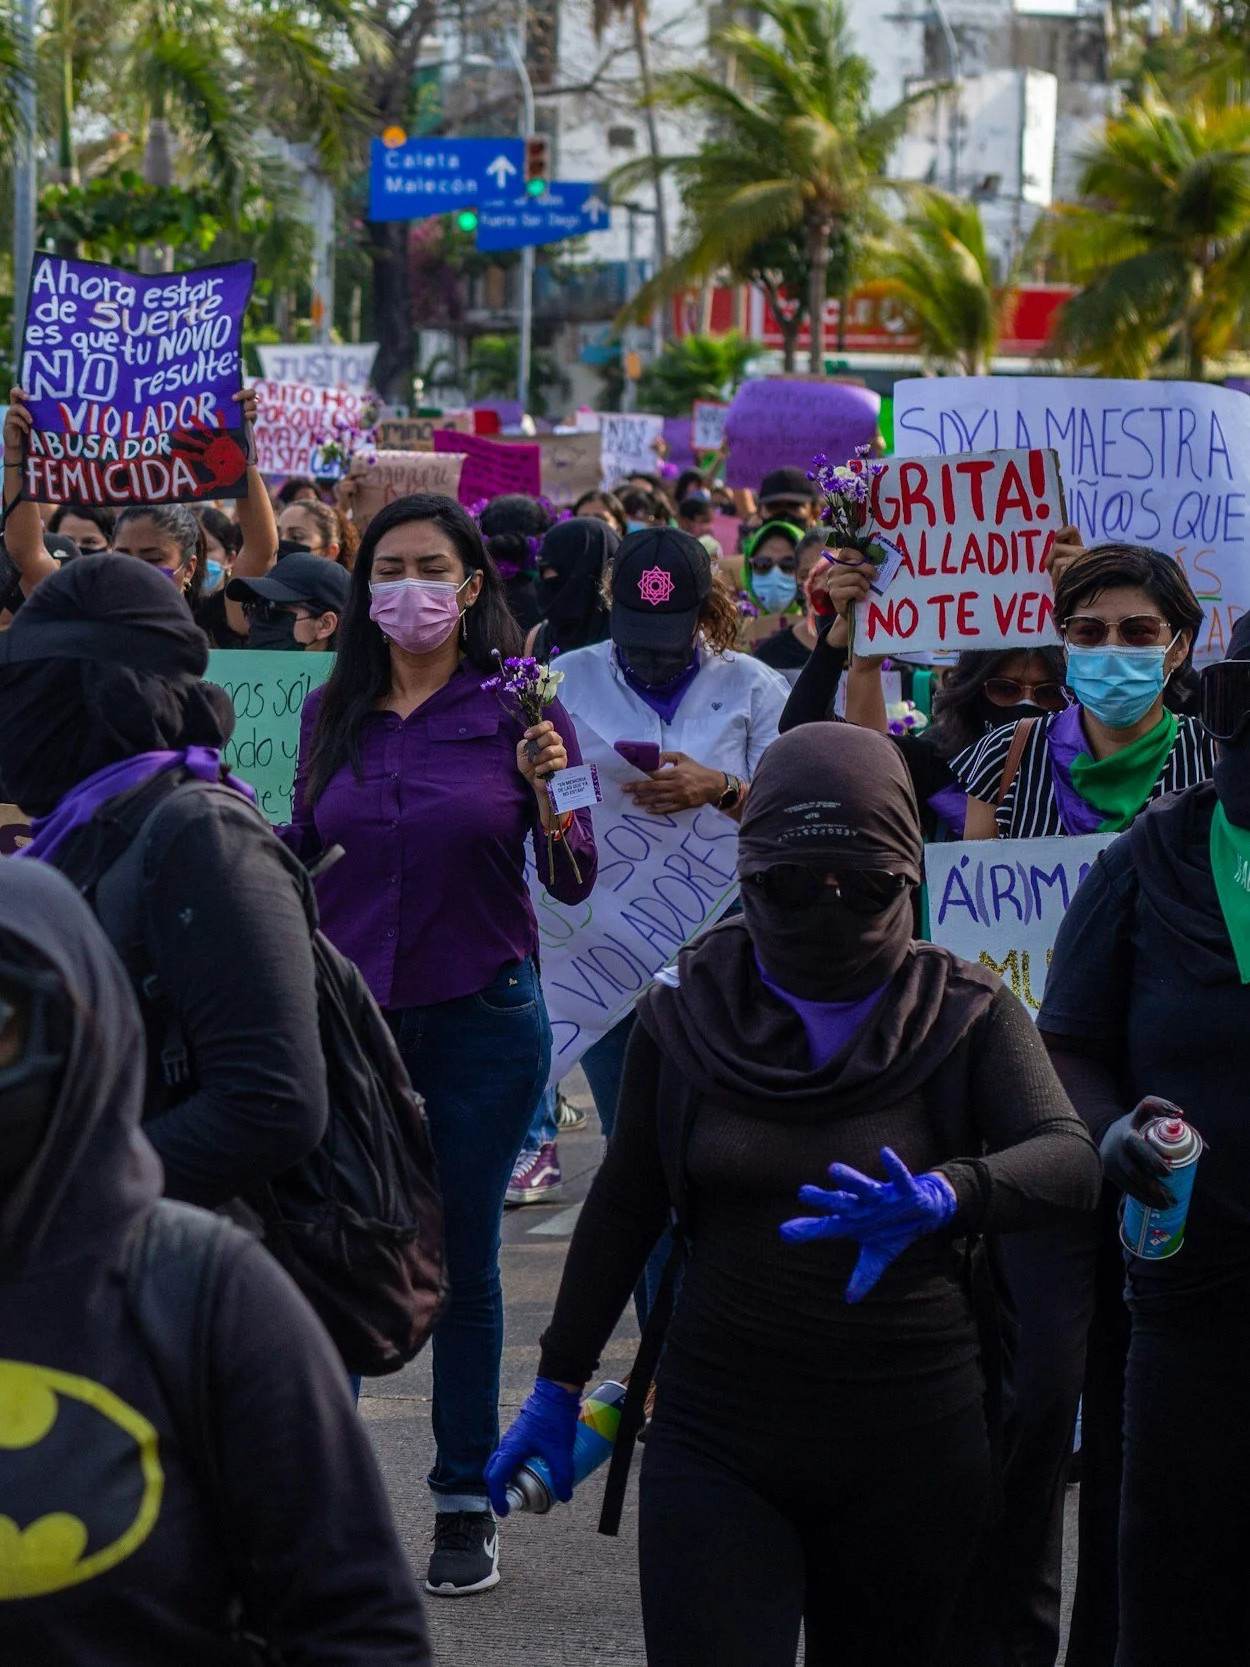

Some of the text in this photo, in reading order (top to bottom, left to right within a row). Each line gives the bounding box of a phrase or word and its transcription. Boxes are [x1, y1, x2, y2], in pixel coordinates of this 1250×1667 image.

[385, 151, 460, 169] Caleta
[33, 258, 224, 309] Ahora estar
[35, 296, 78, 324] de
[25, 315, 232, 366] es que tu NOVIO
[22, 350, 239, 404] NO resulte:
[59, 392, 219, 439] VIOLADOR
[29, 429, 173, 461] ABUSADOR
[1046, 406, 1234, 482] MAESTRA
[25, 457, 199, 502] FEMICIDA
[1172, 490, 1246, 544] QUE
[869, 529, 1058, 579] ALLADITA
[868, 597, 919, 643] NO
[926, 591, 981, 642] TE
[551, 812, 740, 1011] VIOLADORES
